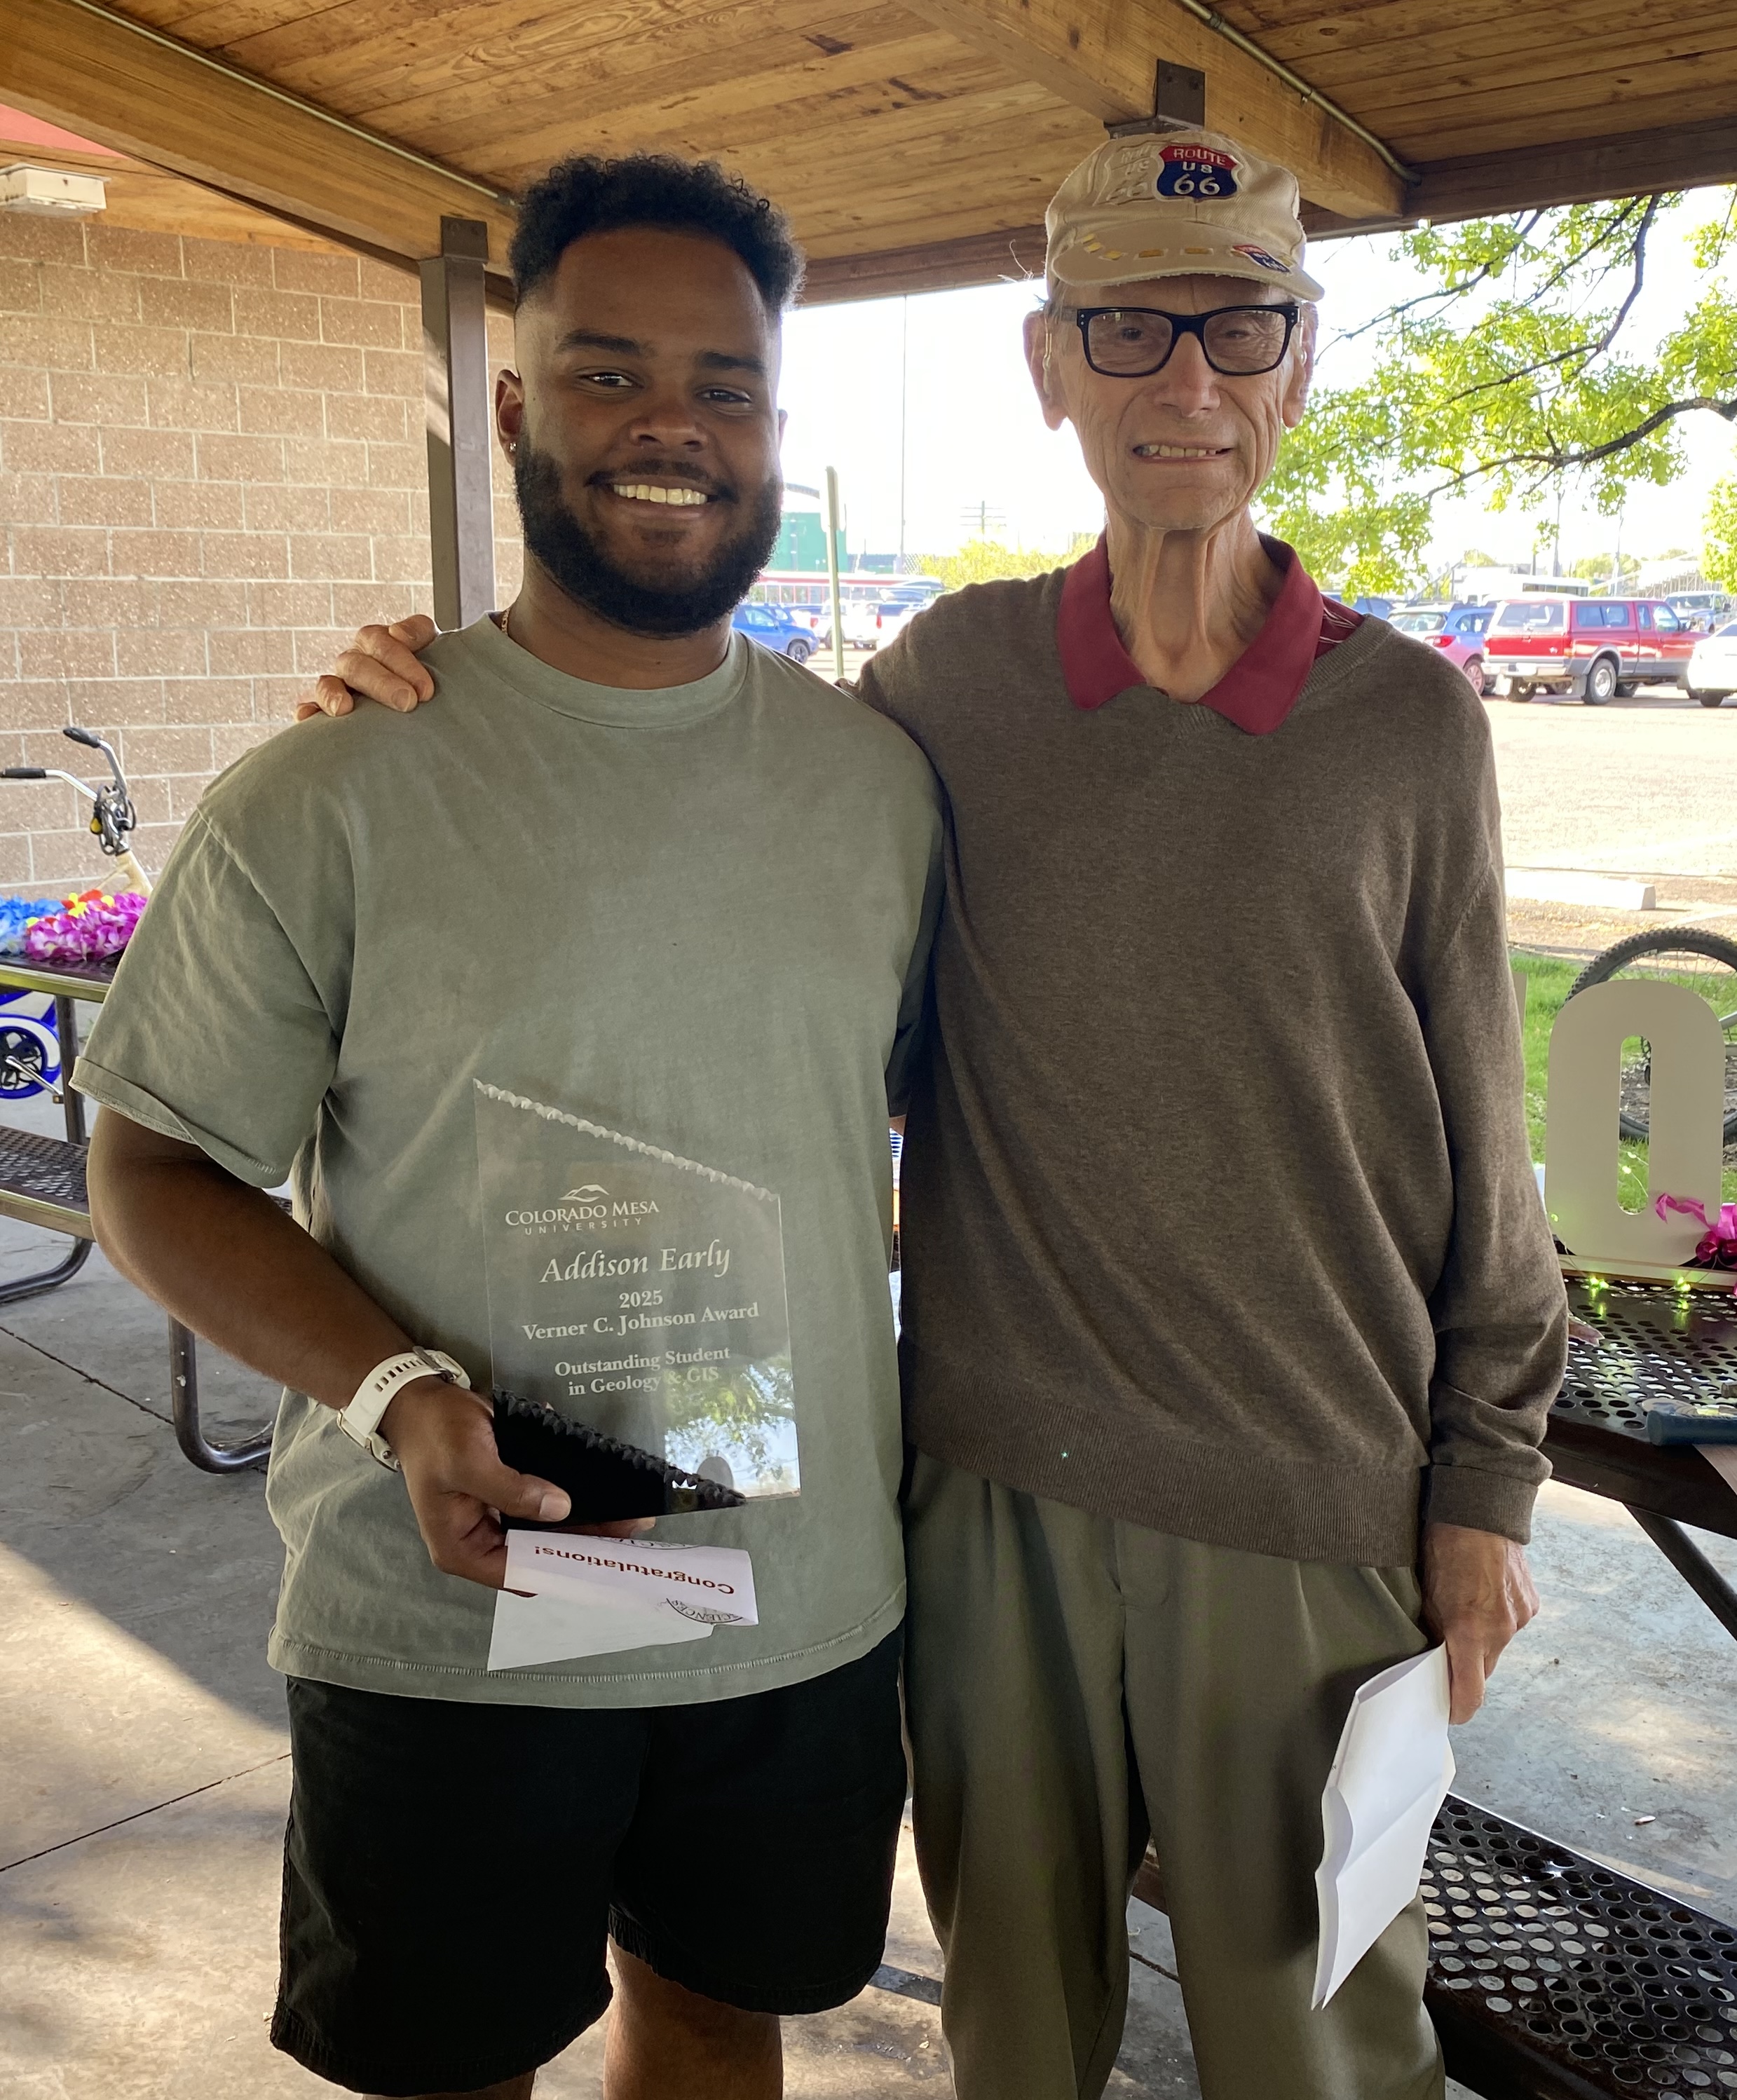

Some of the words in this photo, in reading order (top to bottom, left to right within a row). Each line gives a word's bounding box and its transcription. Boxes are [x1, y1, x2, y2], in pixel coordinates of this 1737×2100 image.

[1173, 148, 1226, 166] ROUTE
[1173, 173, 1220, 196] 66
[505, 1204, 607, 1227] COLORADO
[612, 1200, 660, 1216] MESA
[524, 1217, 643, 1236] UNIVERSITY
[539, 1249, 649, 1283] Addison
[658, 1239, 731, 1278] Early
[618, 1289, 664, 1309] 2025
[522, 1322, 588, 1340] Verner
[593, 1317, 614, 1333] C.
[618, 1311, 696, 1336] Johnson
[701, 1302, 760, 1323] Award
[554, 1354, 660, 1377] Outstanding
[665, 1346, 731, 1365] Student
[568, 1380, 586, 1396] in
[591, 1375, 662, 1393] Geology
[667, 1370, 684, 1385] &
[686, 1366, 719, 1383] GIS
[534, 1546, 735, 1595] Congratulations!
